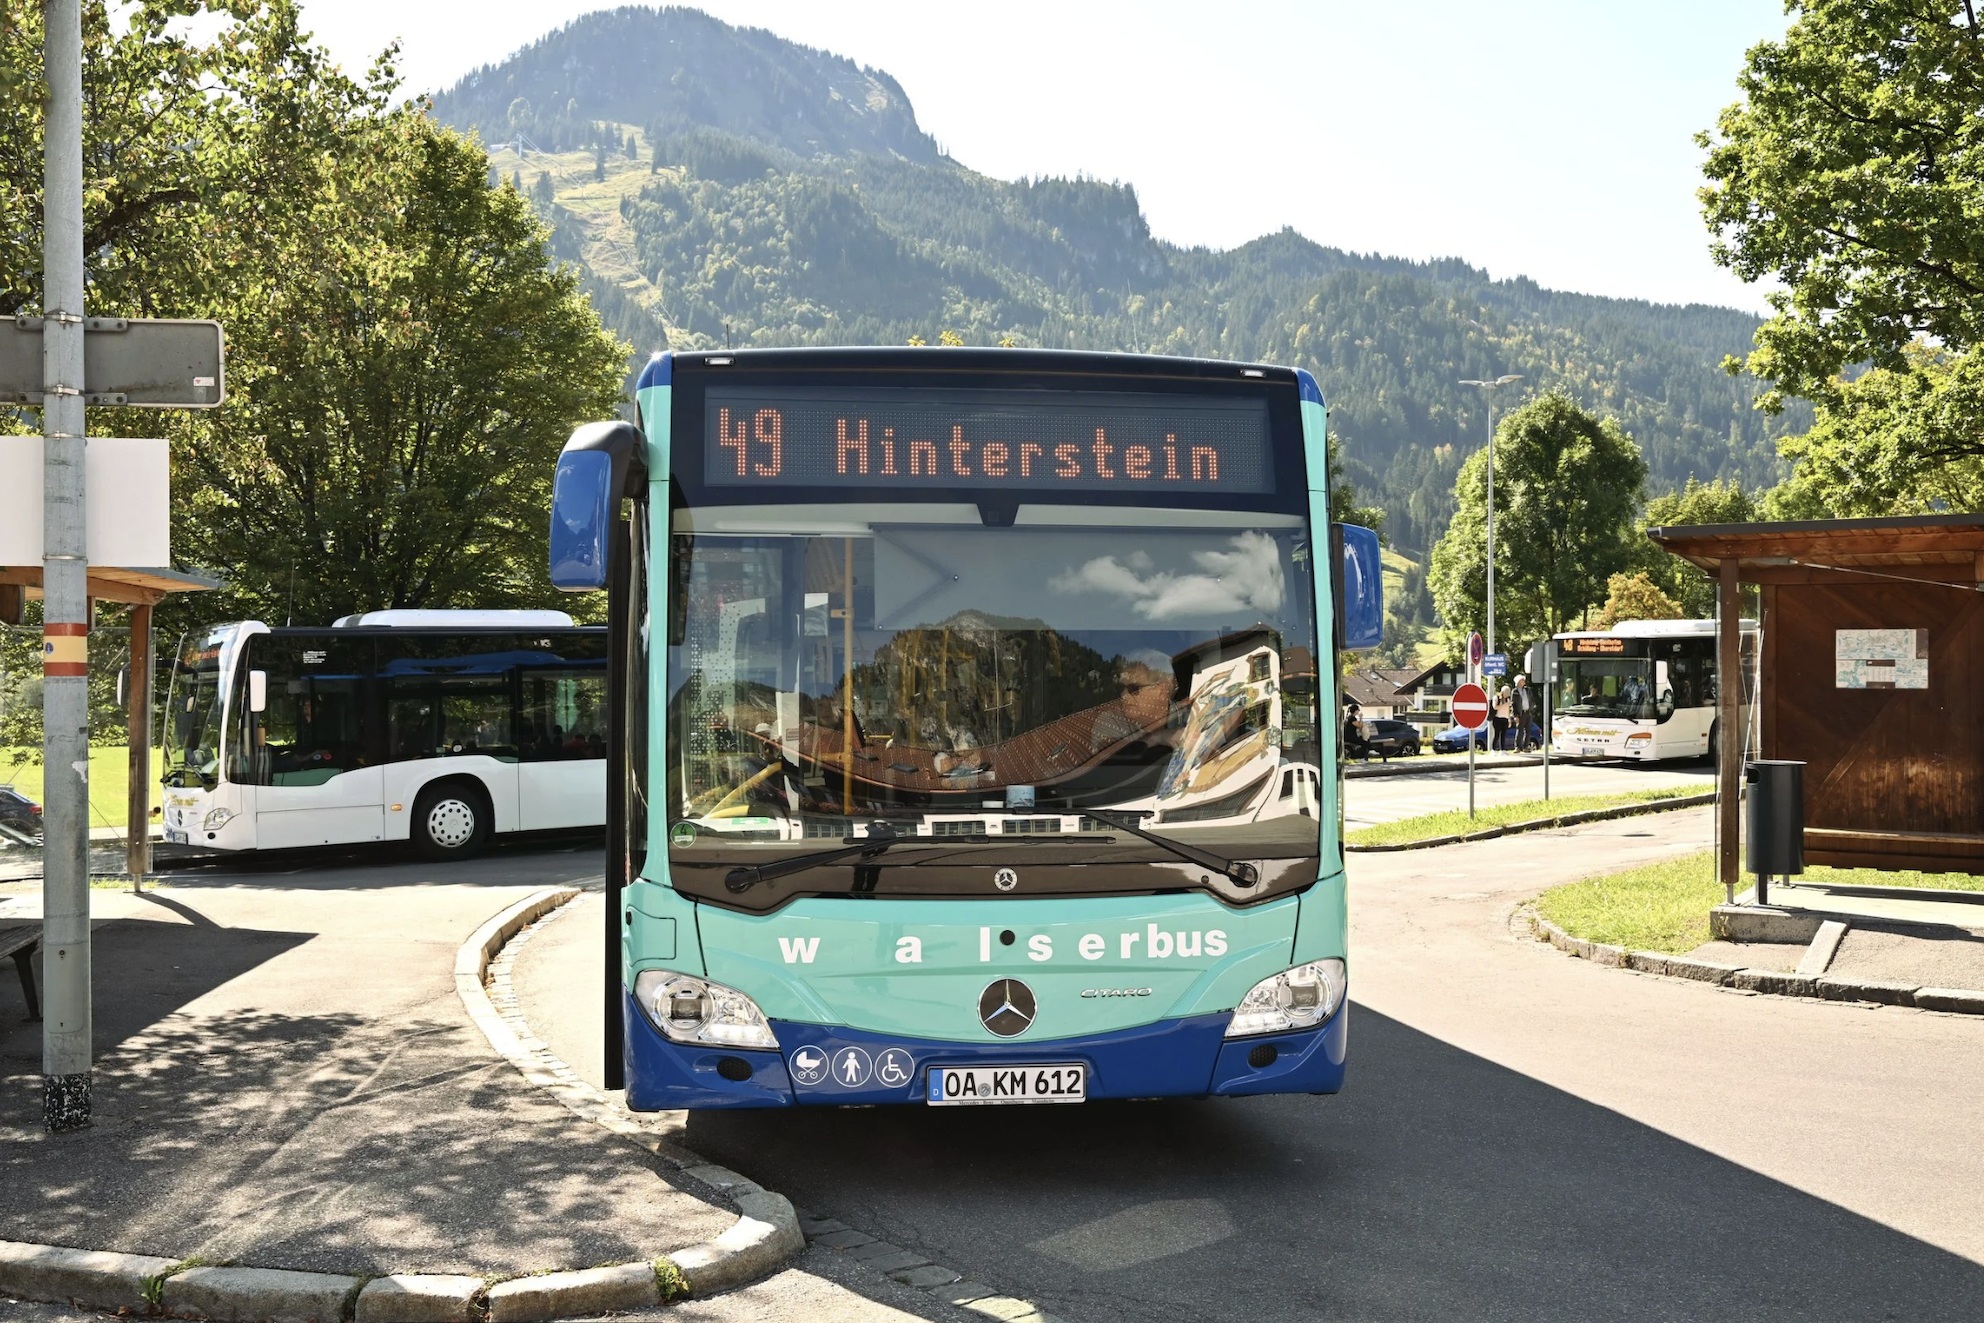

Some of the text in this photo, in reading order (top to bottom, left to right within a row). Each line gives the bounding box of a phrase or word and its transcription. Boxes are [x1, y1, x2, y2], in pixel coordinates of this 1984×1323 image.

[720, 408, 1218, 480] 49 Hinterstein
[680, 824, 687, 835] 4
[1081, 988, 1153, 998] CITARO
[945, 1070, 1081, 1097] OA KM 612
